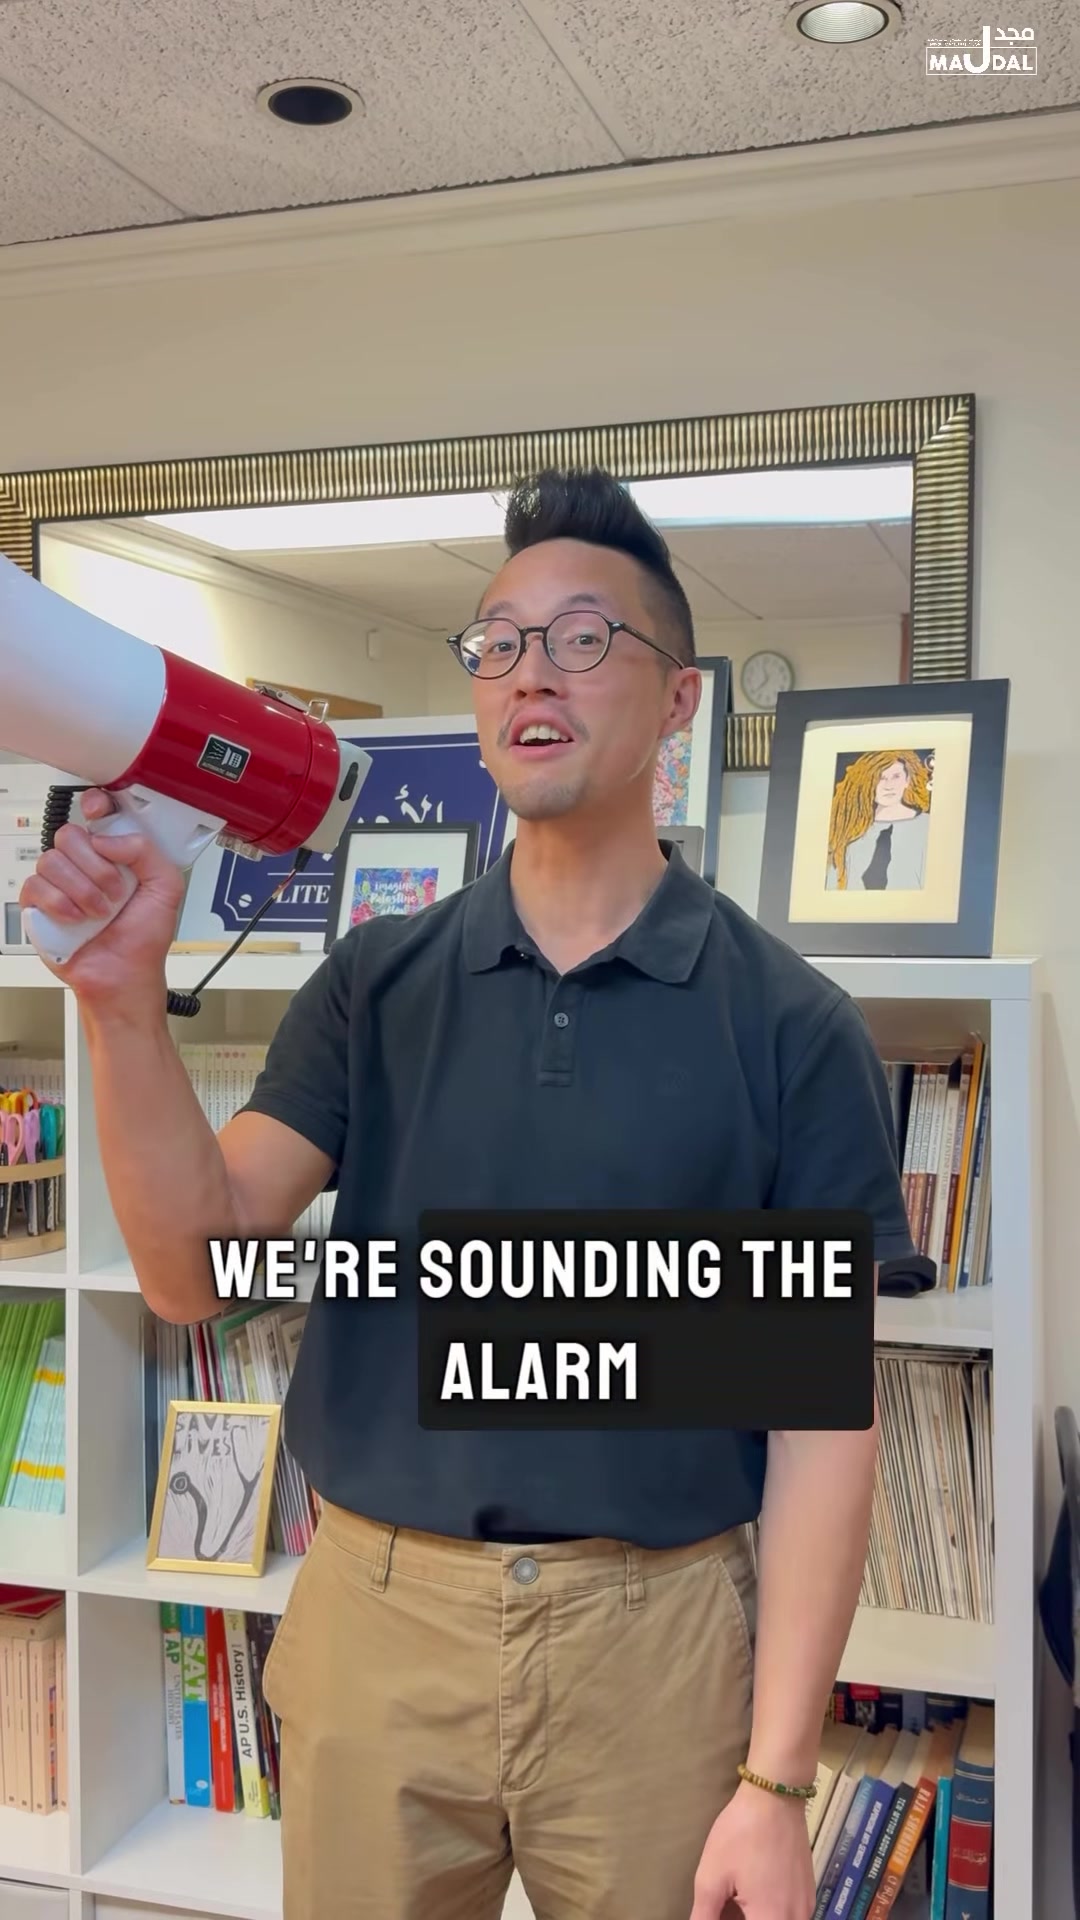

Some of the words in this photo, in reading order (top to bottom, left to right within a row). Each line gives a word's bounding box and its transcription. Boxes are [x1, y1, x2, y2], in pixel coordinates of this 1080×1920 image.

[165, 1639, 181, 1665] AP
[183, 1637, 206, 1699] SAT
[232, 1649, 246, 1701] History
[237, 1705, 249, 1735] U.S.
[241, 1737, 253, 1758] AP
[913, 1787, 931, 1813] RAJA
[878, 1834, 892, 1856] ABOUT
[868, 1856, 883, 1879] ISRAEL
